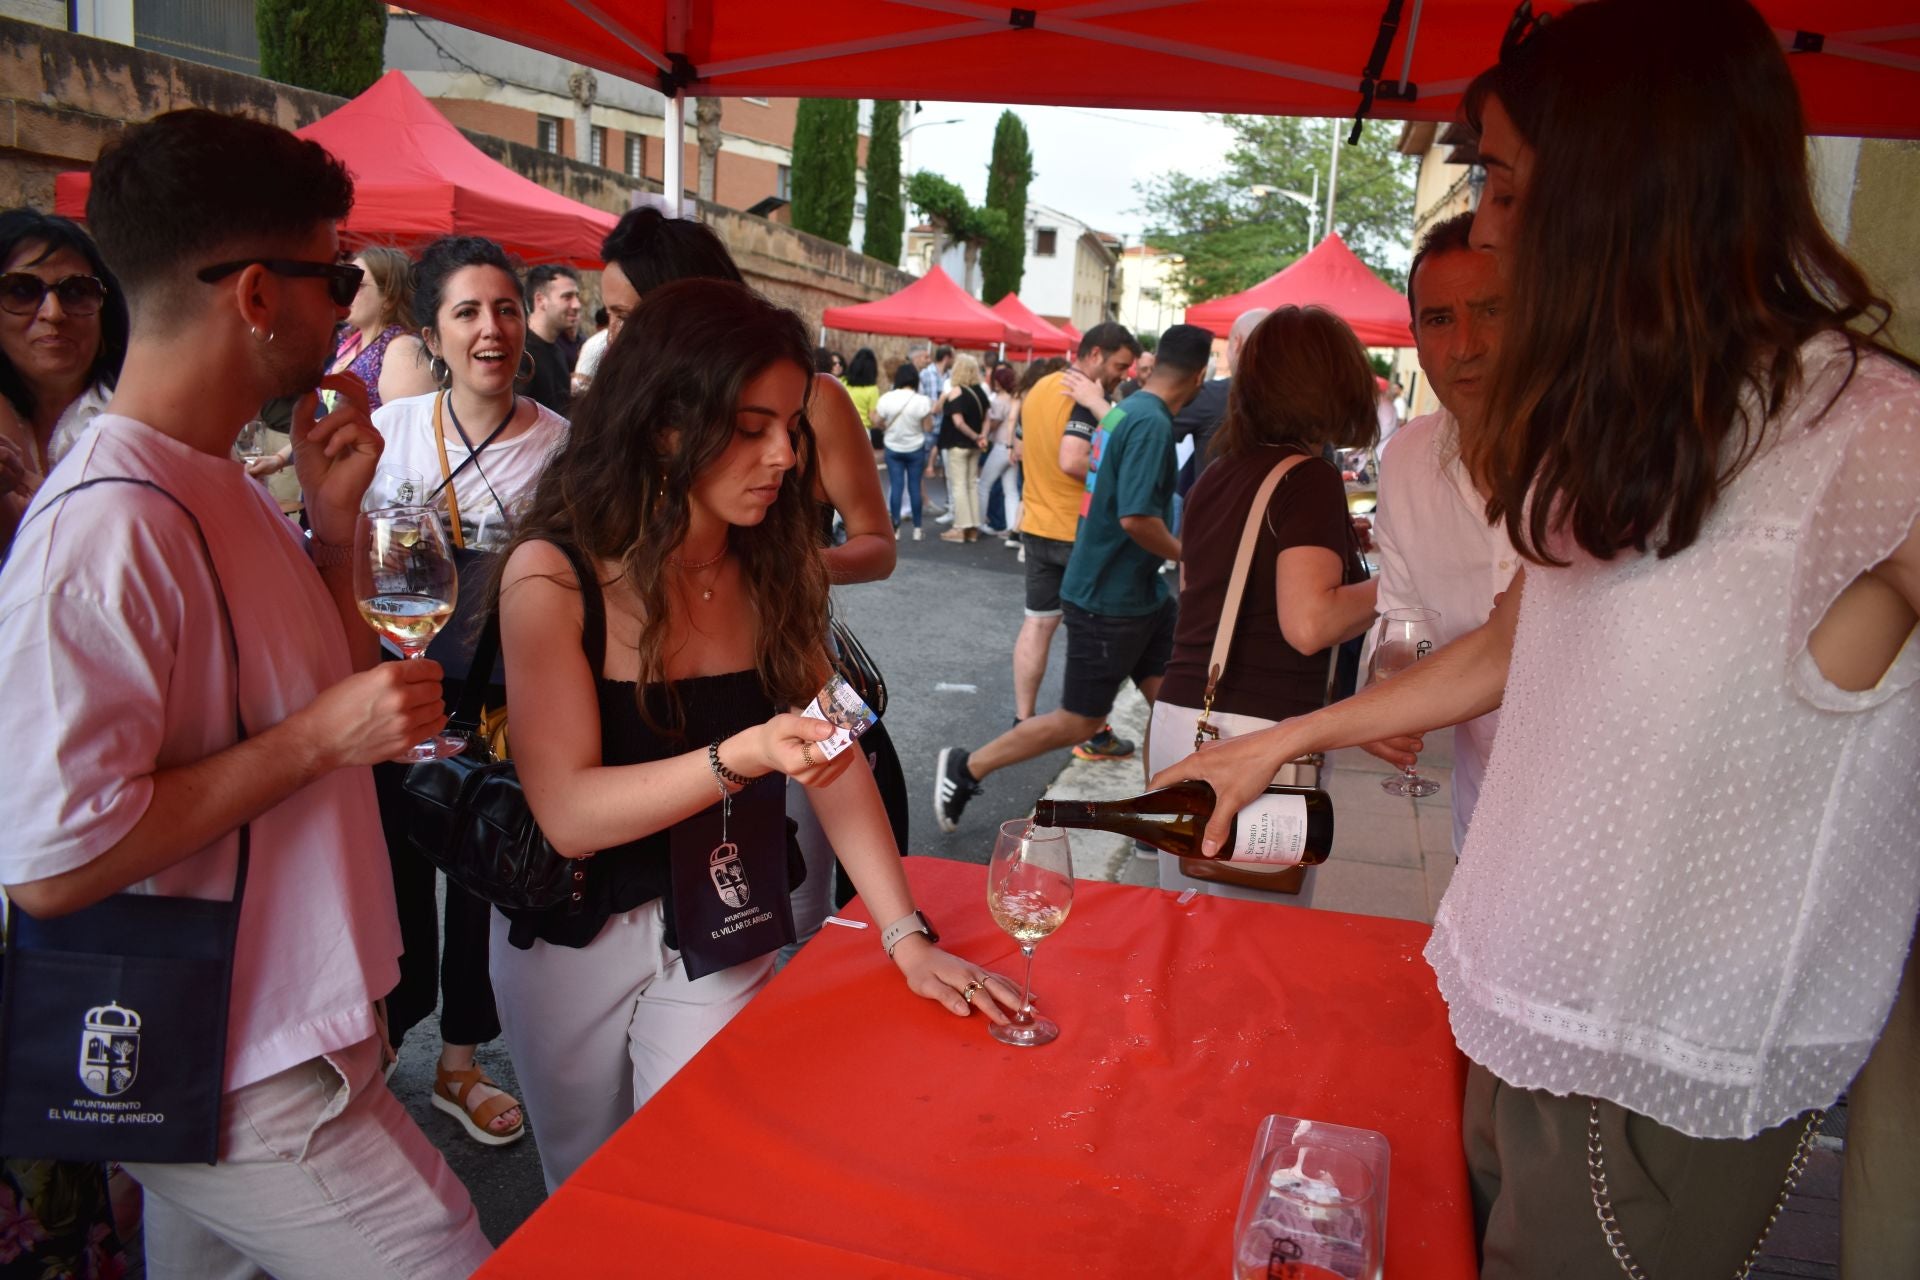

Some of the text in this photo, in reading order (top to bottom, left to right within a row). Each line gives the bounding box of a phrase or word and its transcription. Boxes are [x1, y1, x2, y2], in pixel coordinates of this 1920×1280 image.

[1257, 812, 1269, 844] ERALTA
[1255, 845, 1265, 855] LA
[724, 906, 760, 924] AYUNTAMIENTO
[711, 911, 773, 940] EL VILLAR DE ARNEDO
[73, 1099, 142, 1111] AYUNTAMIENTO
[49, 1108, 164, 1124] EL VILLAR DE ARNEDO
